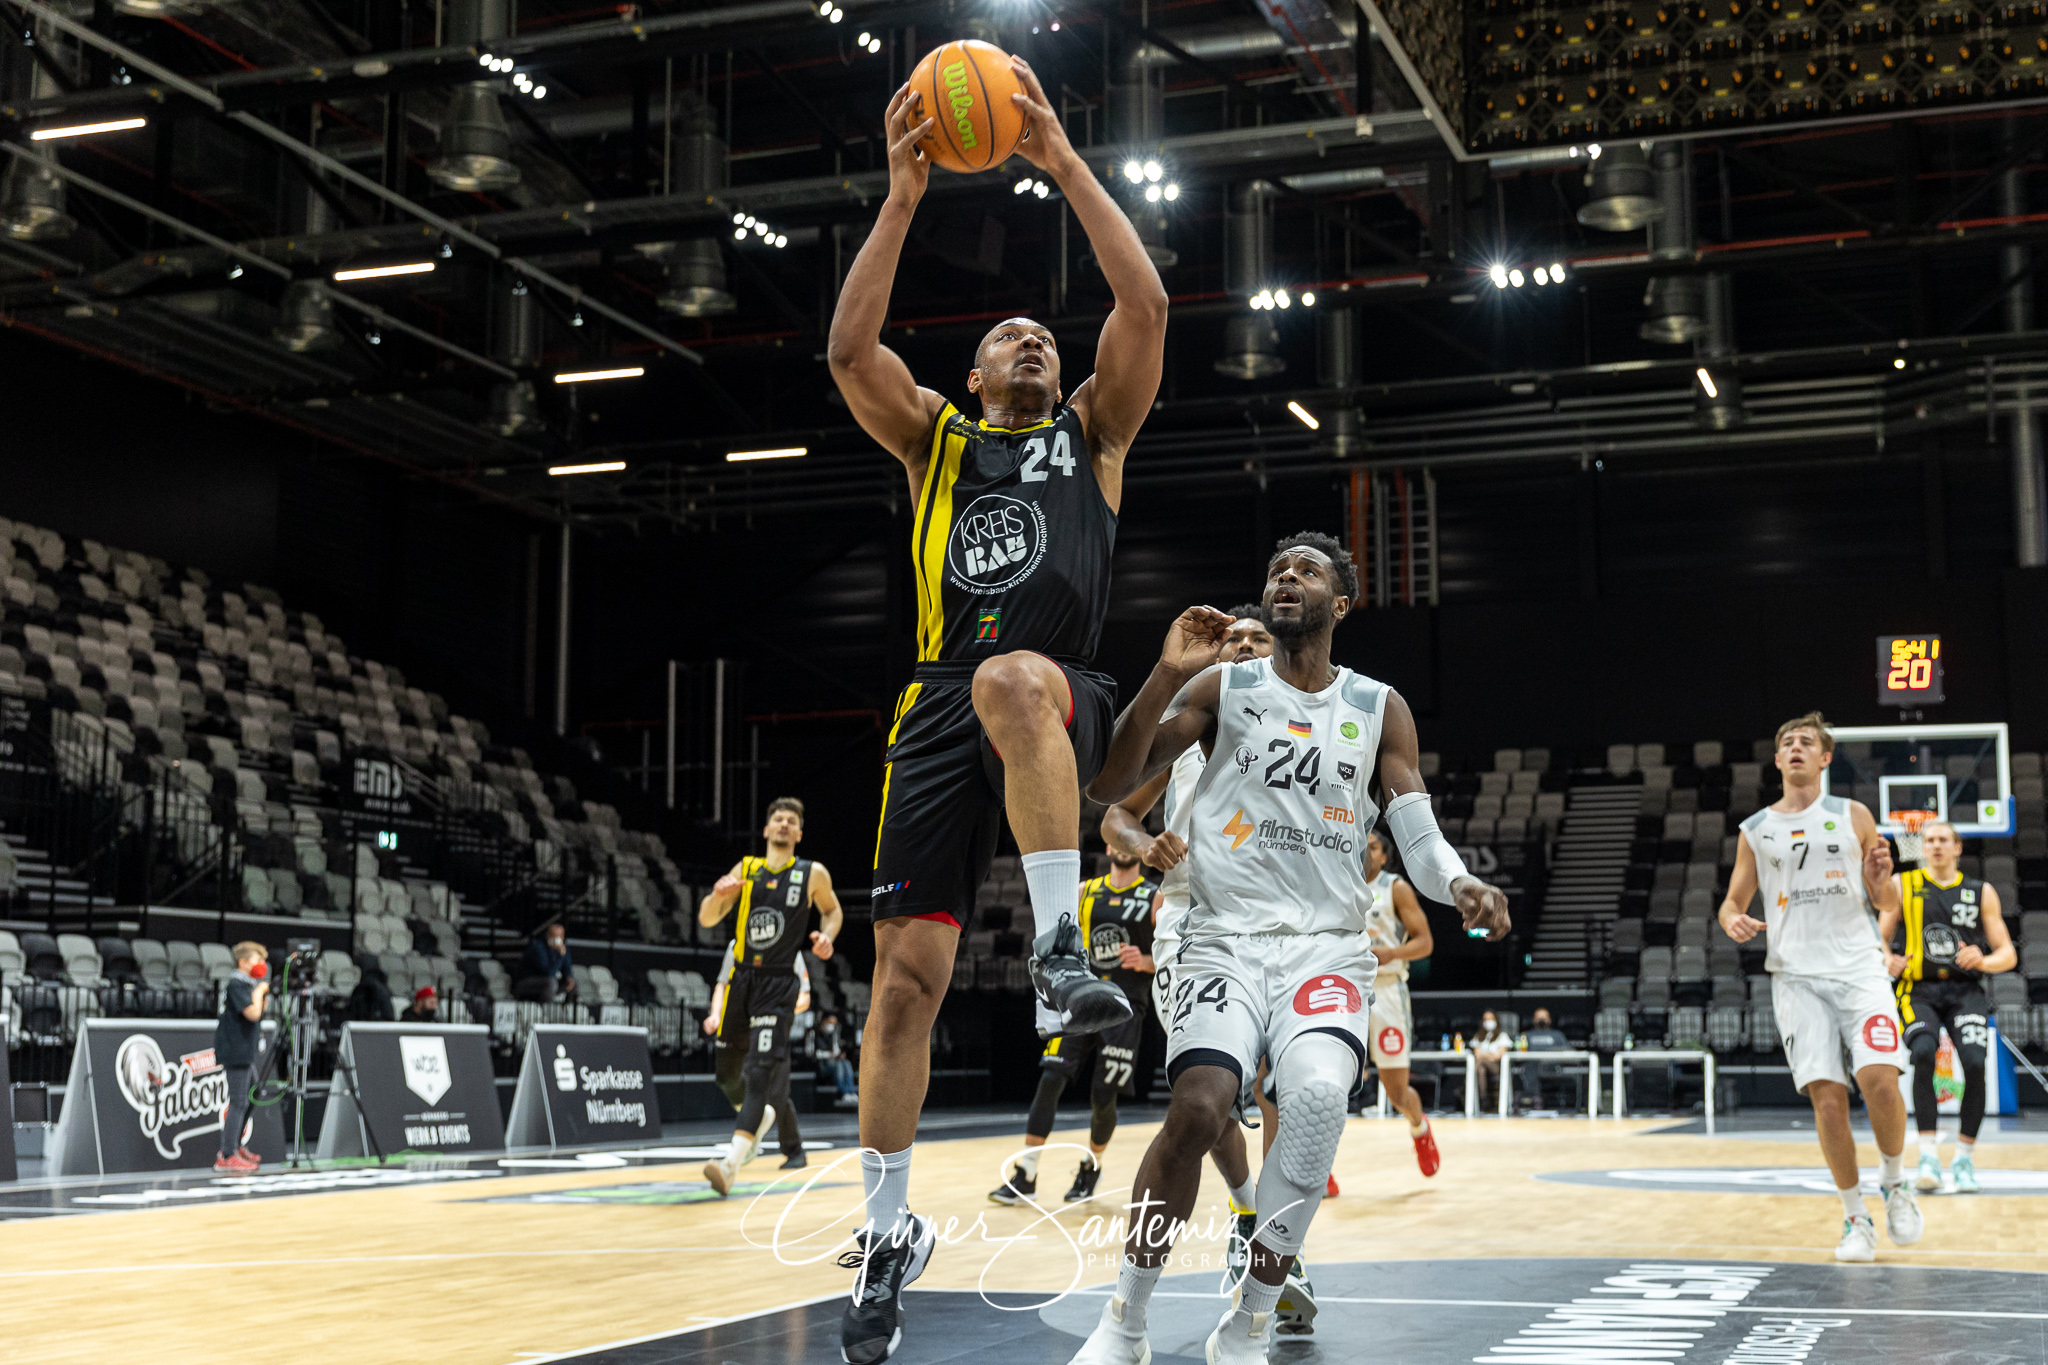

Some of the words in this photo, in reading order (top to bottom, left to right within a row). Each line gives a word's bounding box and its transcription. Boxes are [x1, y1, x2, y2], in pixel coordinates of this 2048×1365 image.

[943, 59, 978, 150] Wilson
[1020, 431, 1076, 483] 24
[960, 505, 1024, 549] KREIS
[965, 532, 1027, 577] BAU
[1887, 659, 1932, 690] 20
[1264, 738, 1321, 795] 24
[1322, 805, 1355, 825] EMS
[1258, 819, 1353, 854] filmstudio
[1258, 839, 1308, 856] nürnberg
[1791, 842, 1809, 870] 7
[785, 885, 802, 908] 6
[1121, 898, 1150, 922] 77
[1951, 903, 1979, 929] 32
[1172, 976, 1229, 1026] 24
[758, 1028, 774, 1053] 6
[1961, 1024, 1987, 1048] 32
[580, 1065, 644, 1096] Sparkasse
[1104, 1059, 1133, 1087] 77
[141, 1064, 229, 1136] Falcon
[586, 1098, 646, 1128] Nürnberg
